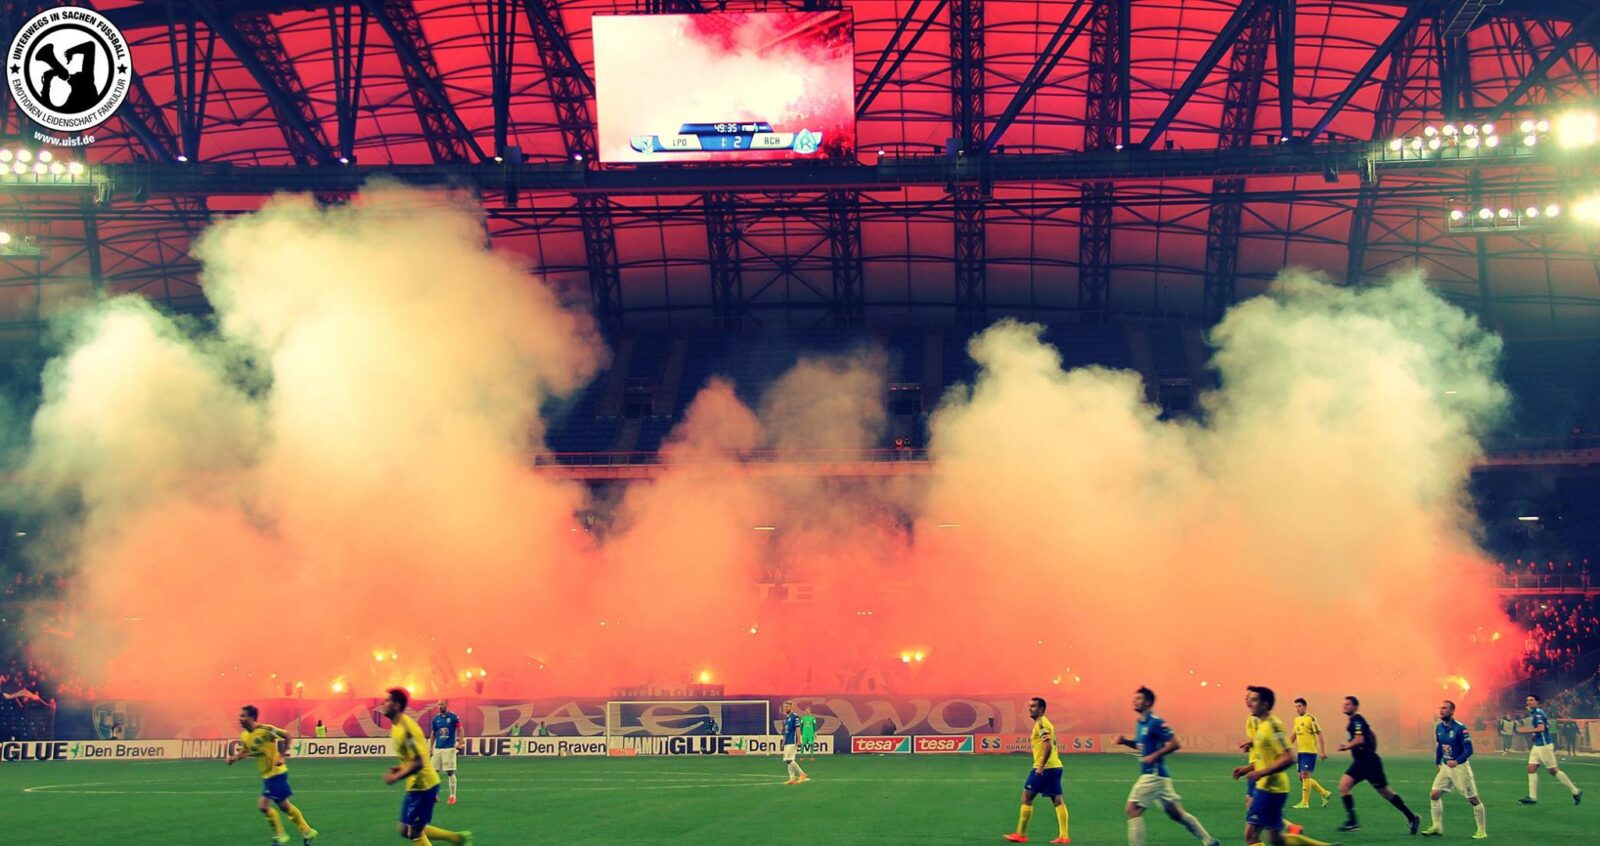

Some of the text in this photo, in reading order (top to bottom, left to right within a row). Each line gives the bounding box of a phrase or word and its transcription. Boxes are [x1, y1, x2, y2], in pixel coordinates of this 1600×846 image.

[85, 743, 165, 757] Den Braven
[182, 740, 228, 758] MAMUT
[308, 742, 386, 755] Den Braven
[528, 740, 607, 753] Den Braven
[669, 736, 733, 755] GLUE
[749, 739, 776, 752] Den
[856, 737, 893, 751] tesa
[918, 736, 956, 750] tesa
[3, 742, 68, 761] GLUE
